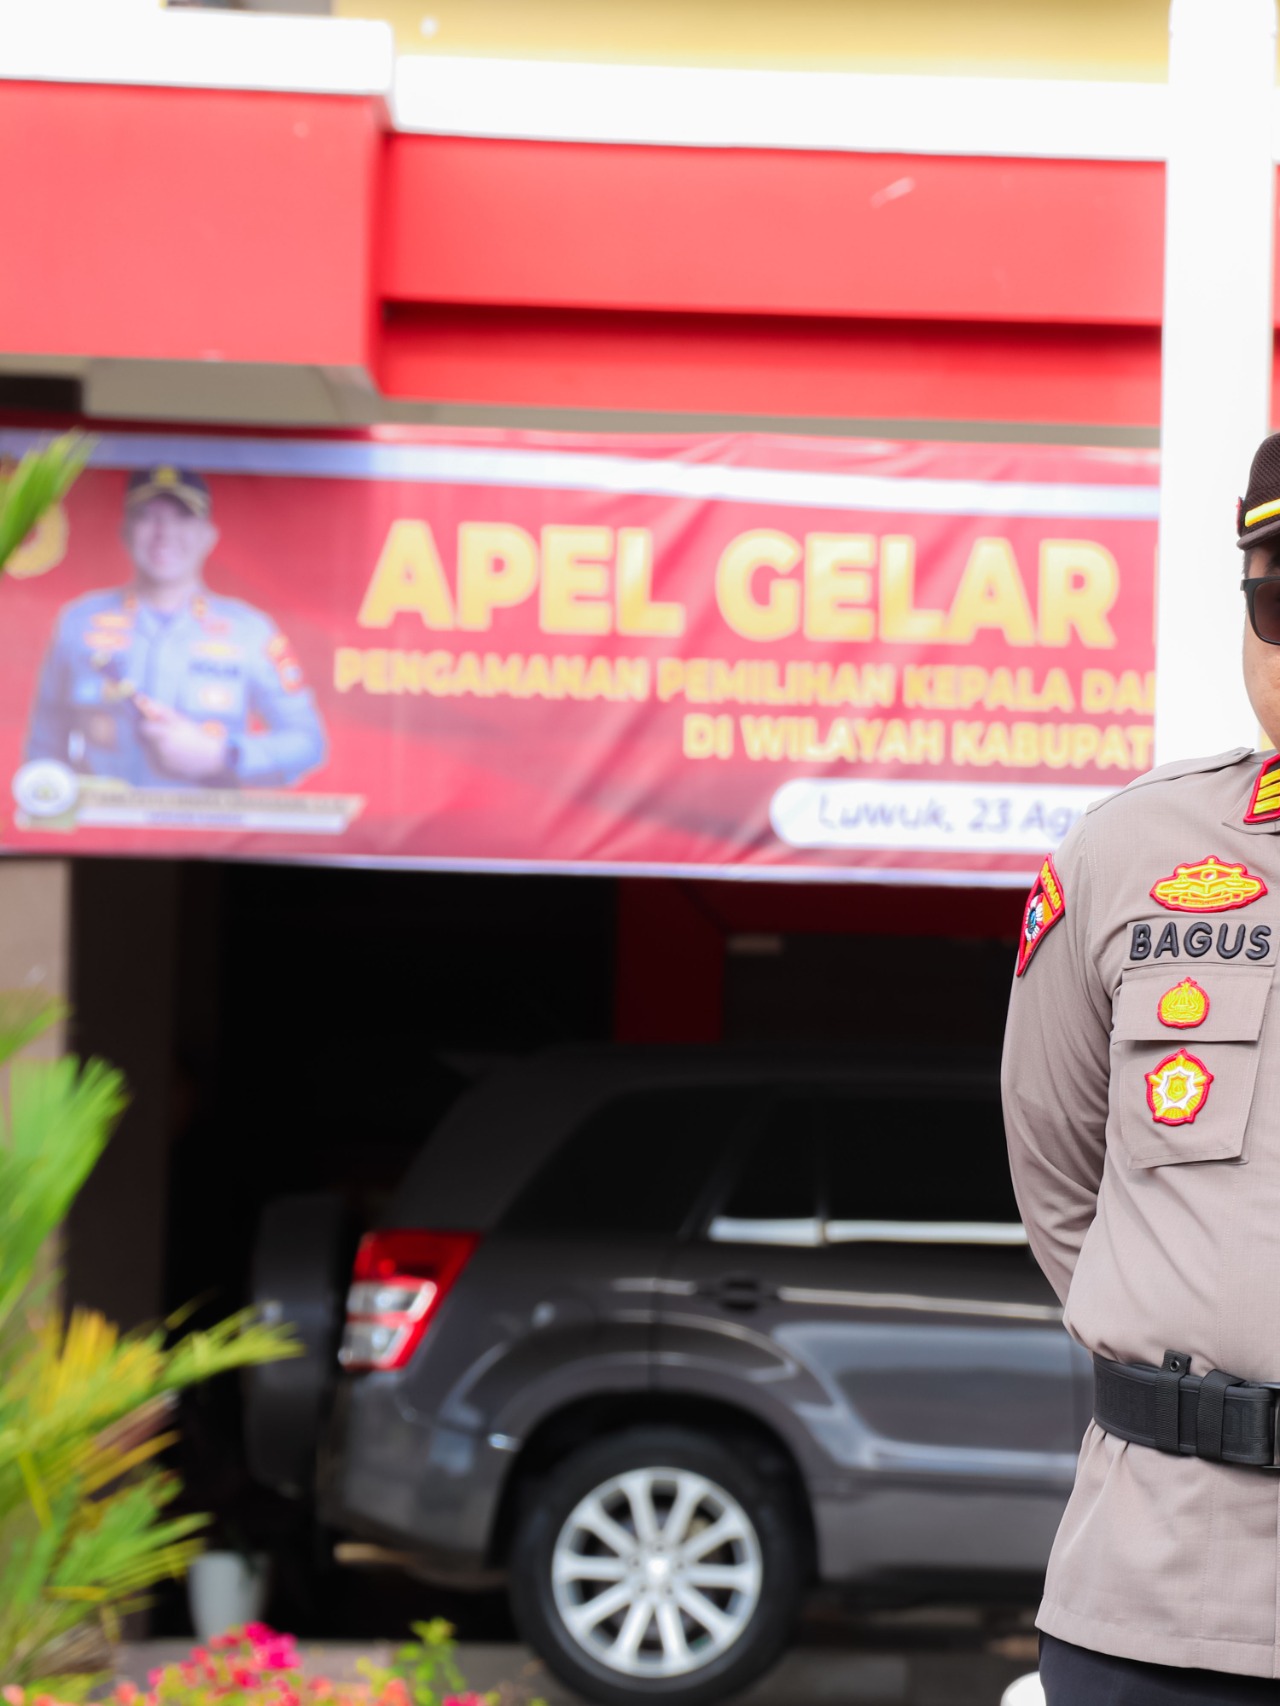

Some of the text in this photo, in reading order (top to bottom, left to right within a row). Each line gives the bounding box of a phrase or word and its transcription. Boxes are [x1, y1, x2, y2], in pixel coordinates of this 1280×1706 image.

[358, 519, 685, 637] APEL
[716, 529, 1119, 648] GELAR
[334, 647, 649, 700] PENGAMANAN
[657, 658, 896, 706] PEMILIHAN
[904, 665, 1074, 712] KEPALA
[682, 714, 734, 760] DI
[741, 715, 941, 764] WILAYAH
[969, 798, 1011, 832] 23
[1020, 800, 1083, 844] Ag
[1130, 921, 1272, 961] BAGUS
